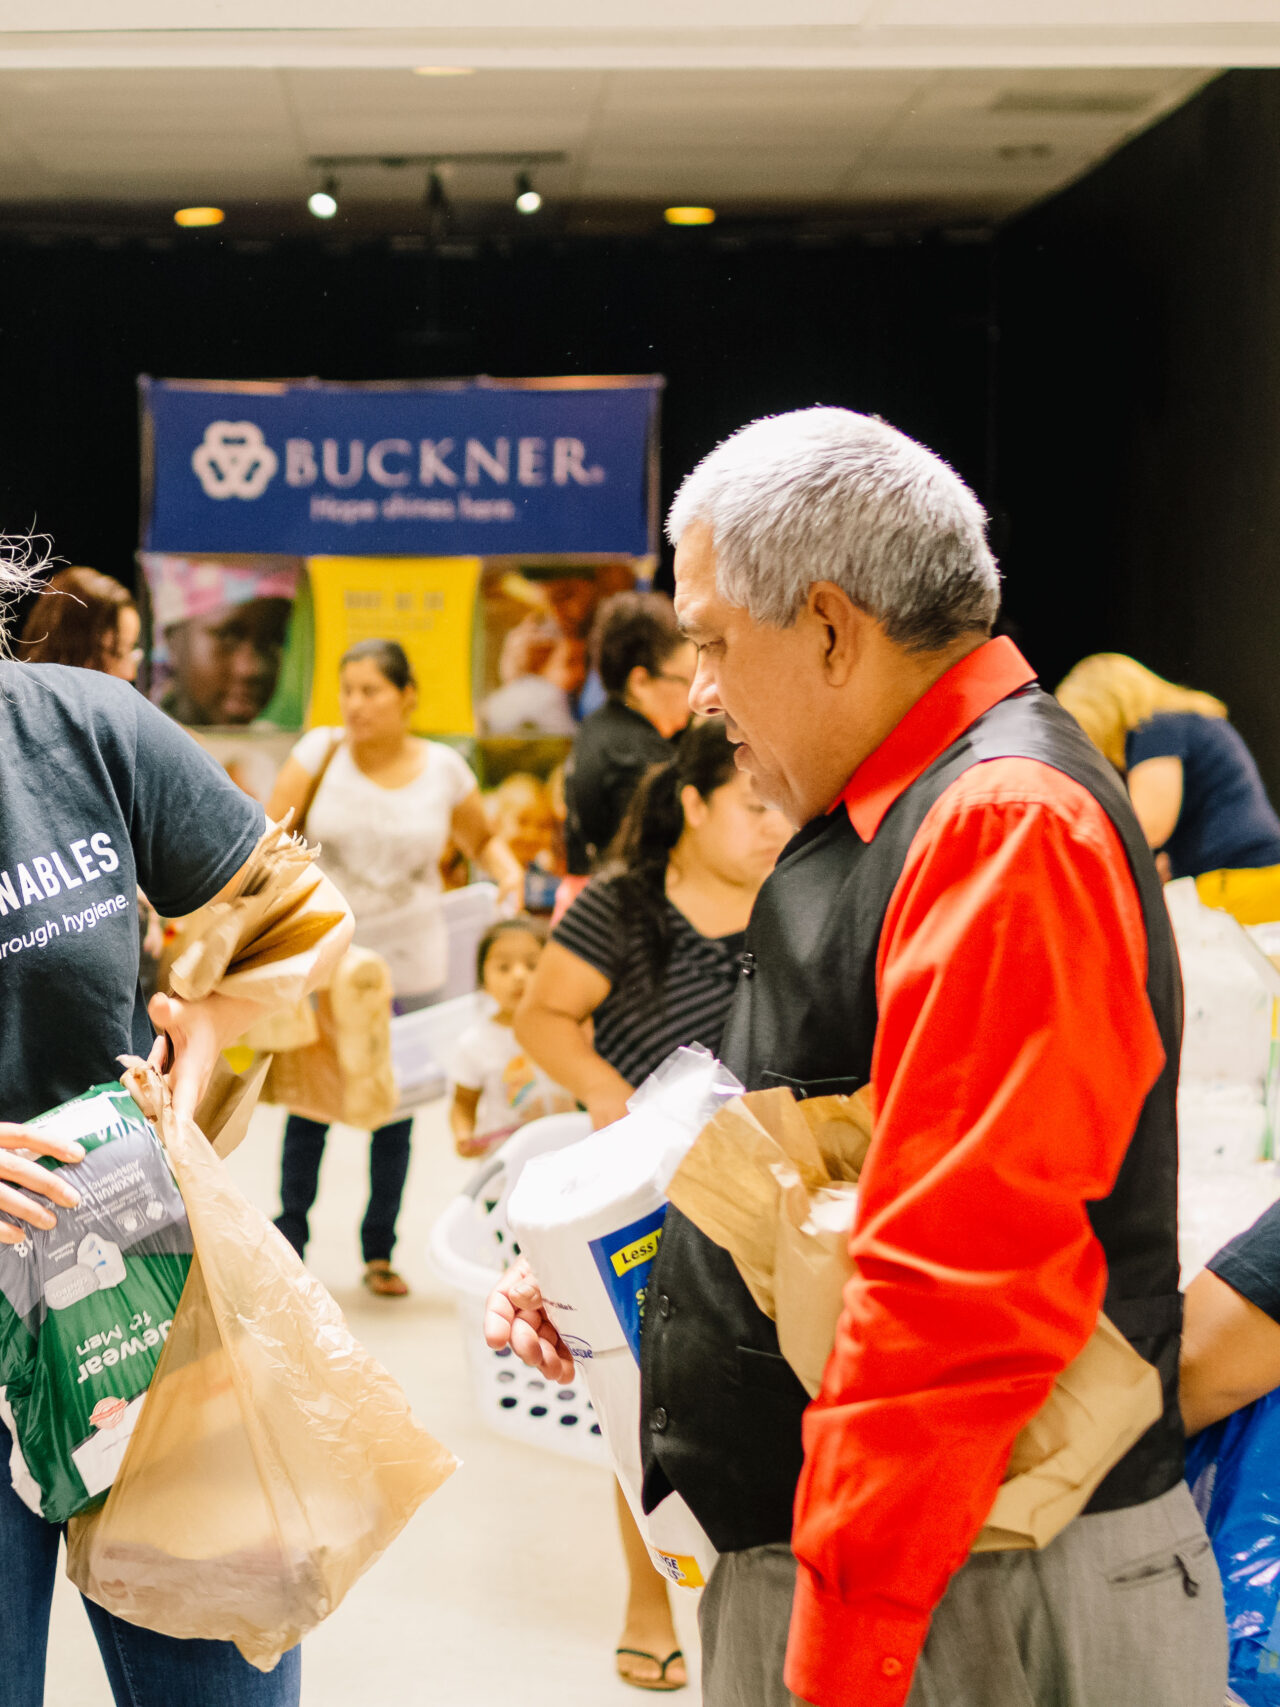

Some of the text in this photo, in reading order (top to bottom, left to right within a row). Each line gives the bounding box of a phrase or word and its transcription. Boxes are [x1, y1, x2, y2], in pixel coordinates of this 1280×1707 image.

[286, 438, 593, 487] BUCKNER
[63, 893, 129, 936] hygiene.
[621, 1242, 654, 1264] Less
[76, 1324, 122, 1356] Men
